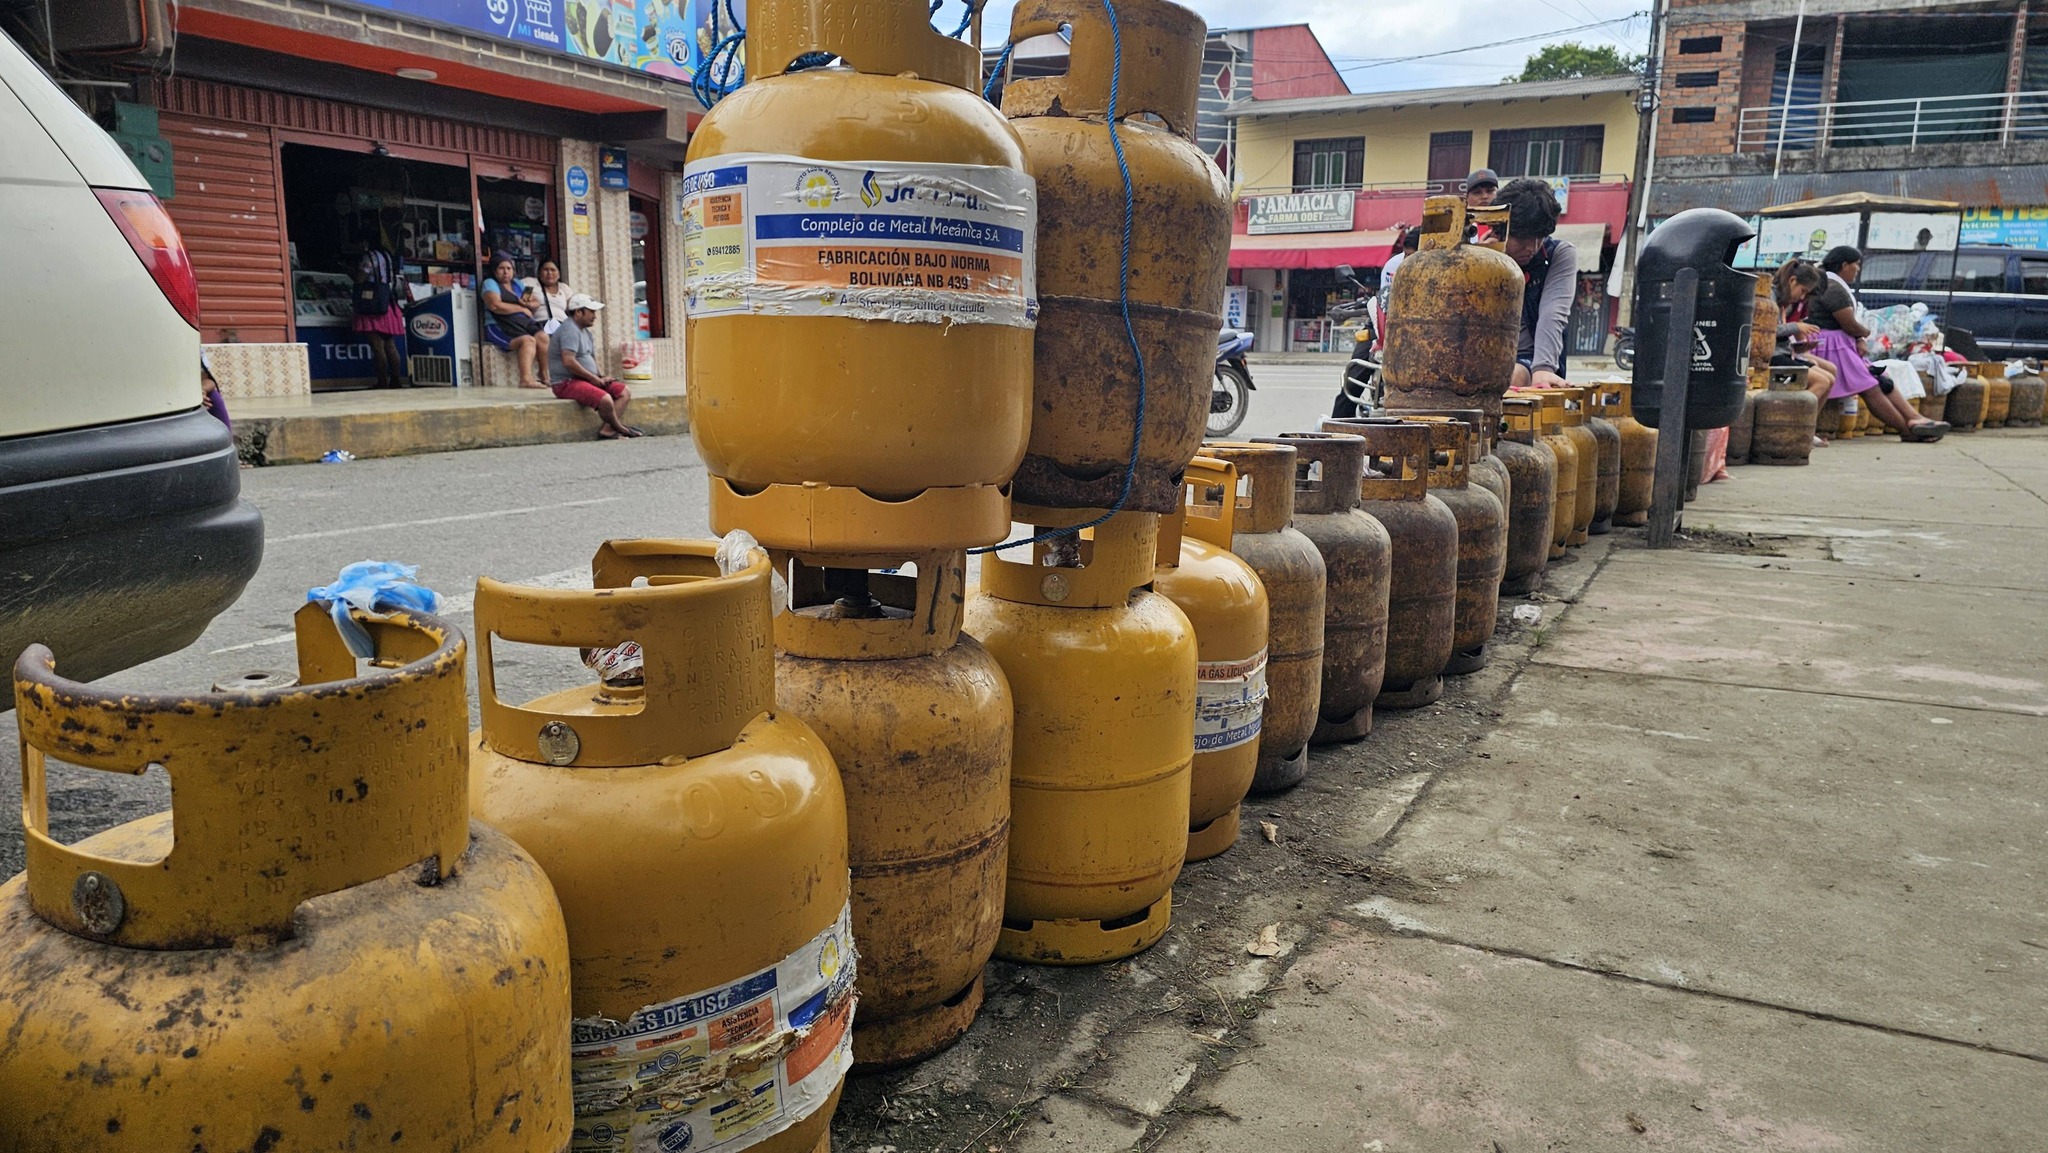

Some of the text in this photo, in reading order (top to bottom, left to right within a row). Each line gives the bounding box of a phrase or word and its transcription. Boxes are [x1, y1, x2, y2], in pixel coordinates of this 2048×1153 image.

[533, 28, 559, 44] tienda
[673, 41, 686, 61] Pil
[1256, 193, 1335, 214] FARMACIA
[1267, 213, 1298, 223] FARMA
[1300, 211, 1325, 222] ODET
[801, 217, 1001, 242] Complejo de Metal Mecánica S.A.
[712, 244, 741, 256] 69412885
[818, 247, 991, 273] FABRICACIÓN BAJO NORMA
[850, 271, 969, 290] BOLIVIANA NB 439
[415, 319, 442, 329] Delizia
[321, 343, 373, 360] TECN
[1208, 667, 1226, 679] GAS
[1211, 734, 1223, 744] de
[1225, 728, 1248, 742] Metal
[663, 1004, 688, 1026] DE
[691, 989, 730, 1018] USO
[721, 1006, 759, 1029] ASISTENCIA
